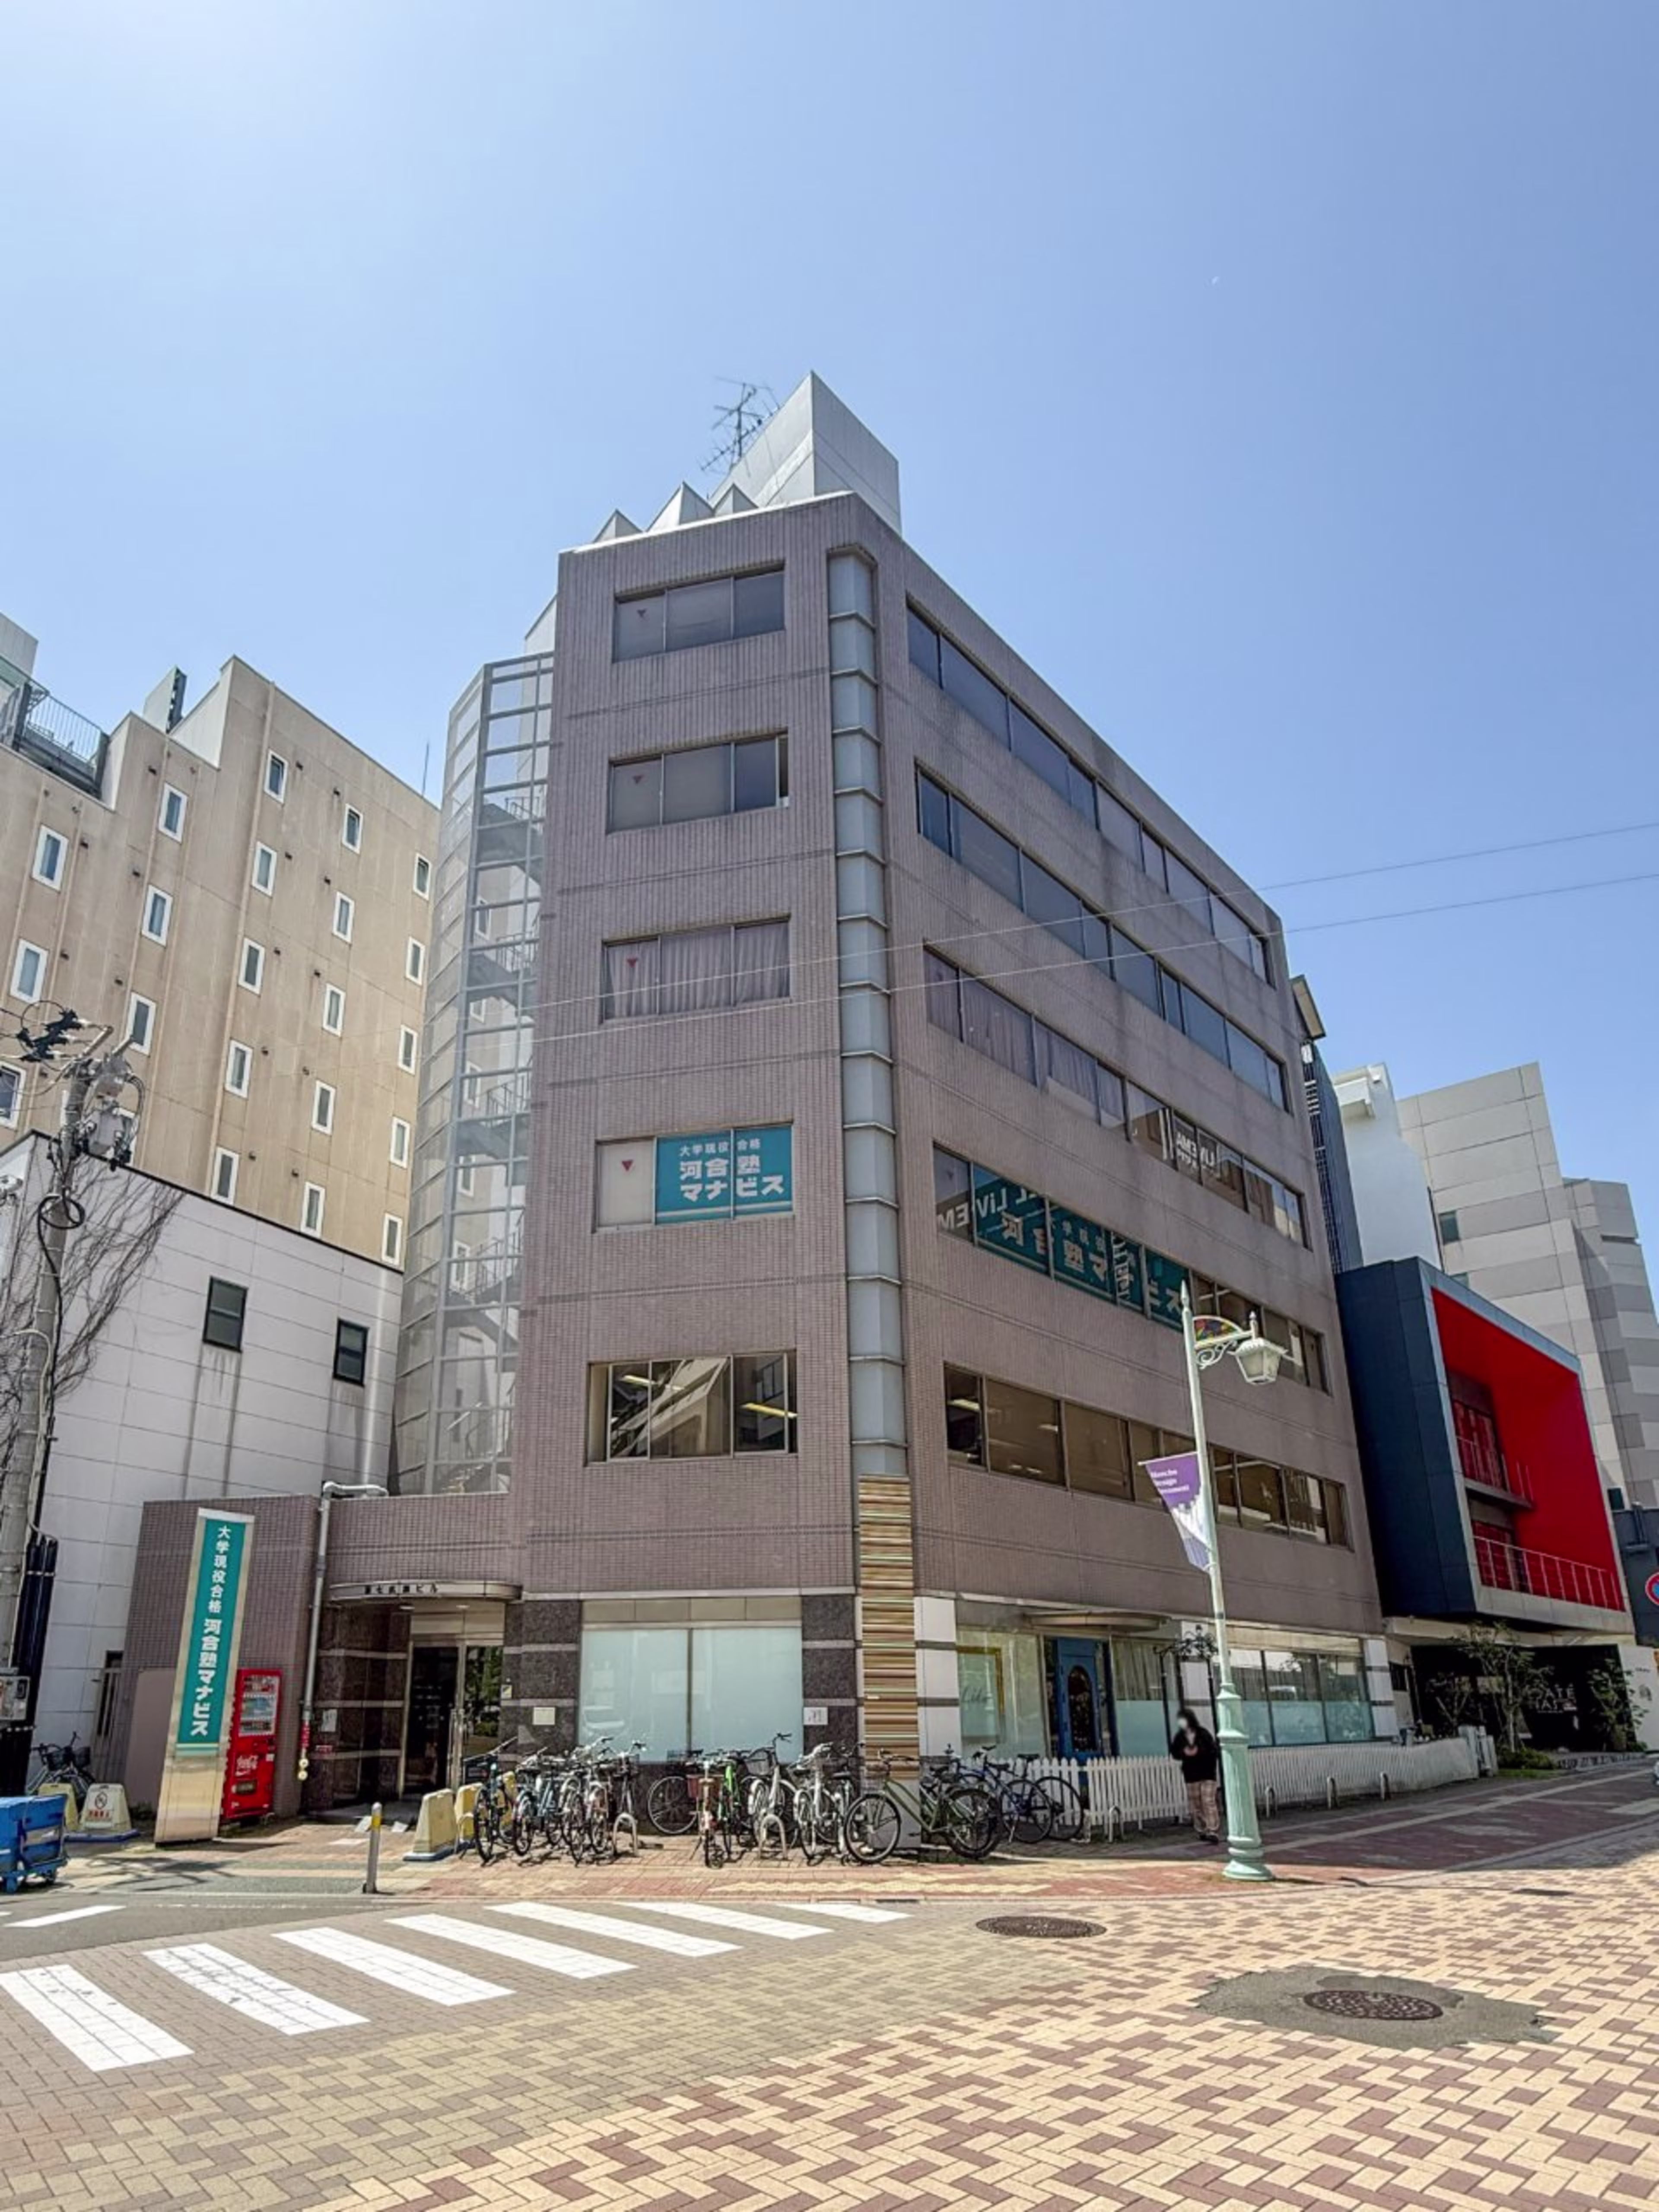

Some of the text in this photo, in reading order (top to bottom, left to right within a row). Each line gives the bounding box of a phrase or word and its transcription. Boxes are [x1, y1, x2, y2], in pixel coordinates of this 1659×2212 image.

[680, 1138, 760, 1157] 大学現役合格
[680, 1154, 760, 1180] 河合塾
[680, 1175, 785, 1201] マナビス
[189, 1525, 232, 1736] 大学現役合格 河合塾マナビス
